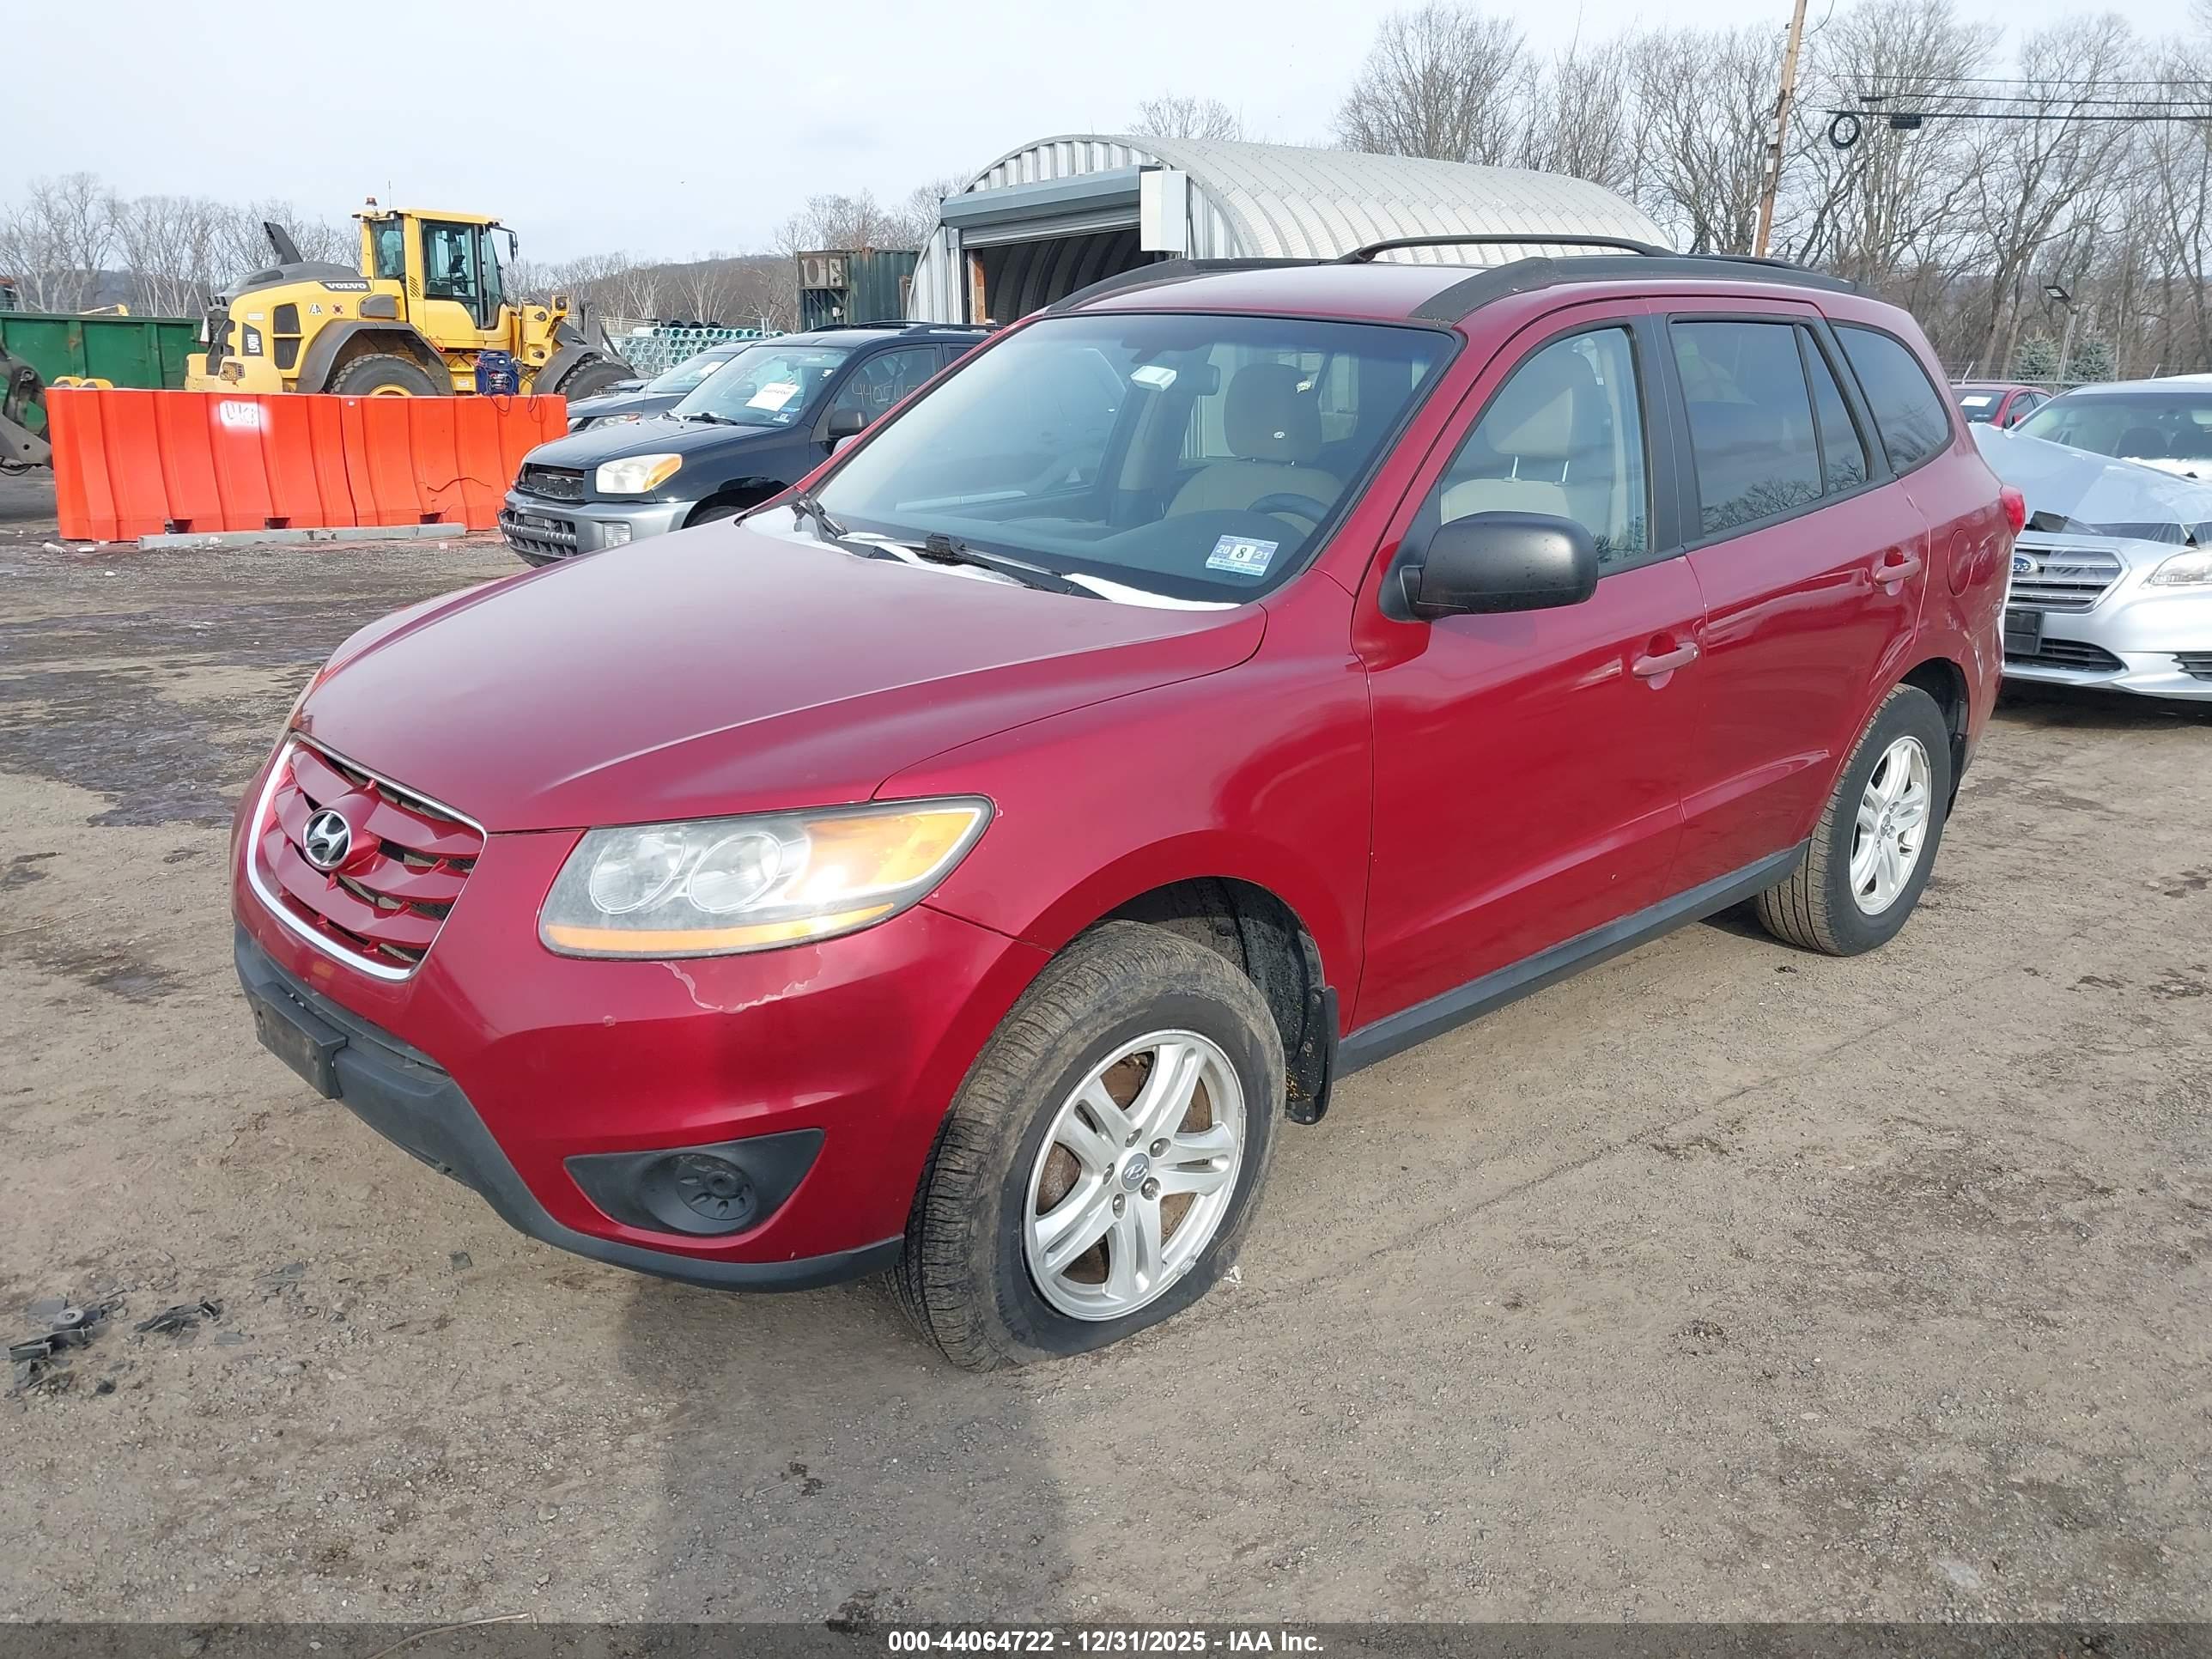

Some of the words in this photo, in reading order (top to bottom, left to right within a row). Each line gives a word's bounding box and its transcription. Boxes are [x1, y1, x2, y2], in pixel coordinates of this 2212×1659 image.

[1215, 544, 1231, 555] 20
[1236, 547, 1248, 559] 8
[1254, 550, 1270, 560] 21
